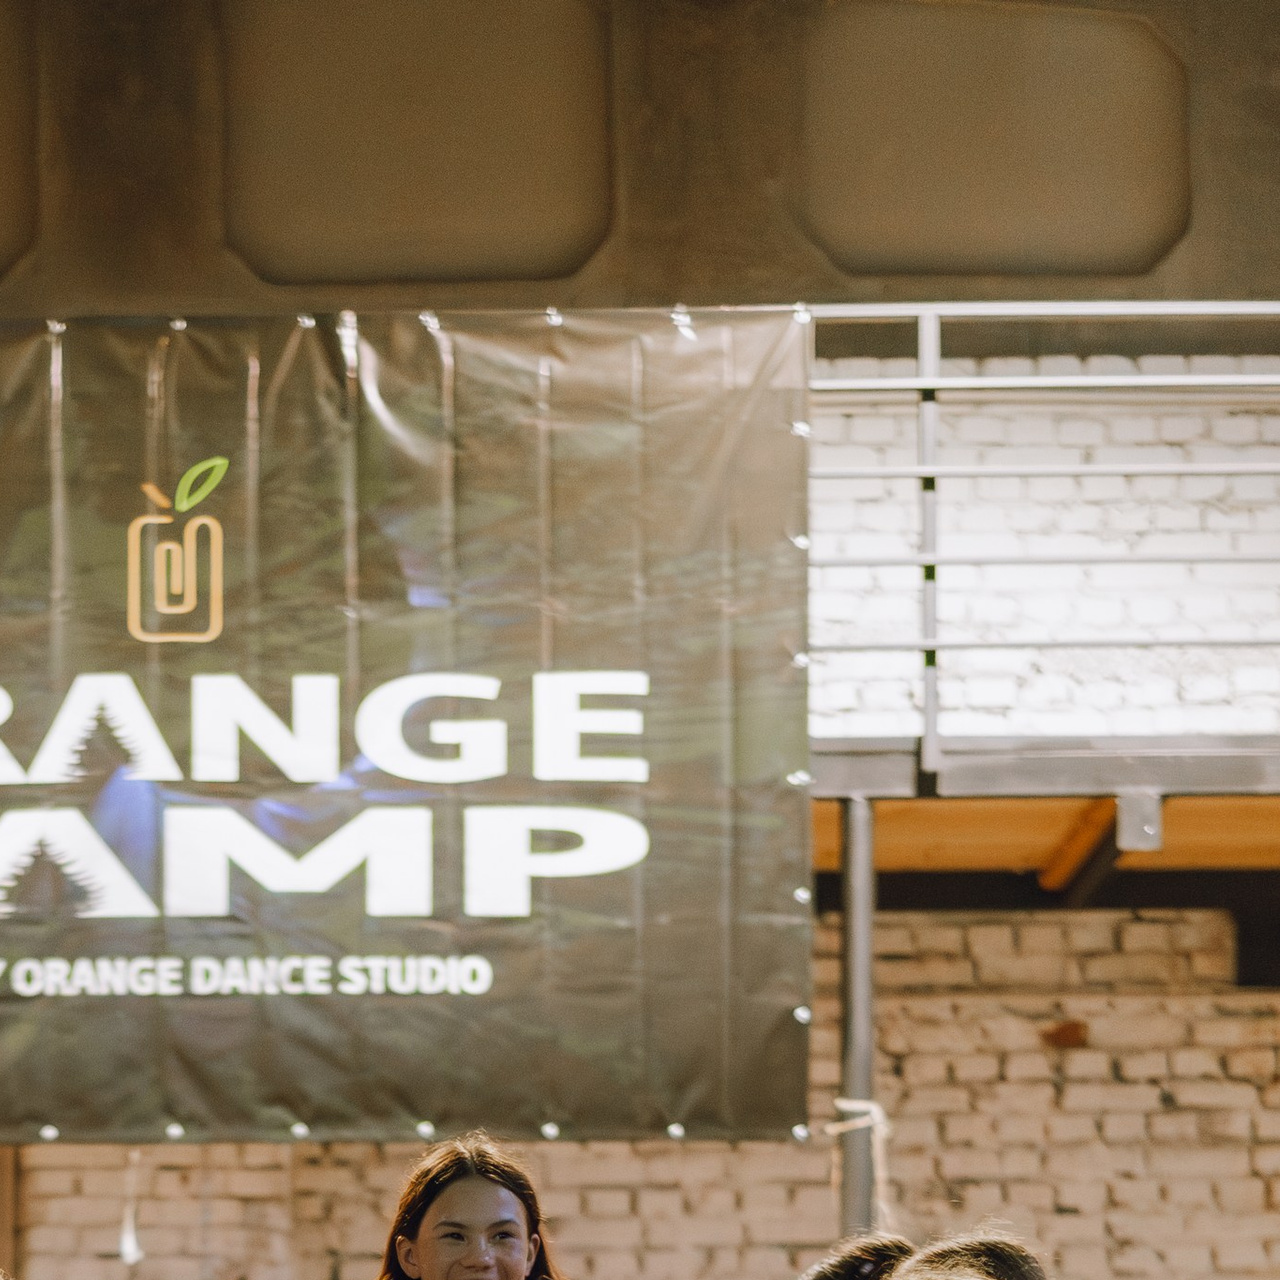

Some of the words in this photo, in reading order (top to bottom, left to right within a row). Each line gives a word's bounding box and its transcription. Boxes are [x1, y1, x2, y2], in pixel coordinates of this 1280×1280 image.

[11, 957, 183, 997] ORANGE
[191, 956, 332, 996] DANCE
[337, 955, 493, 996] STUDIO
